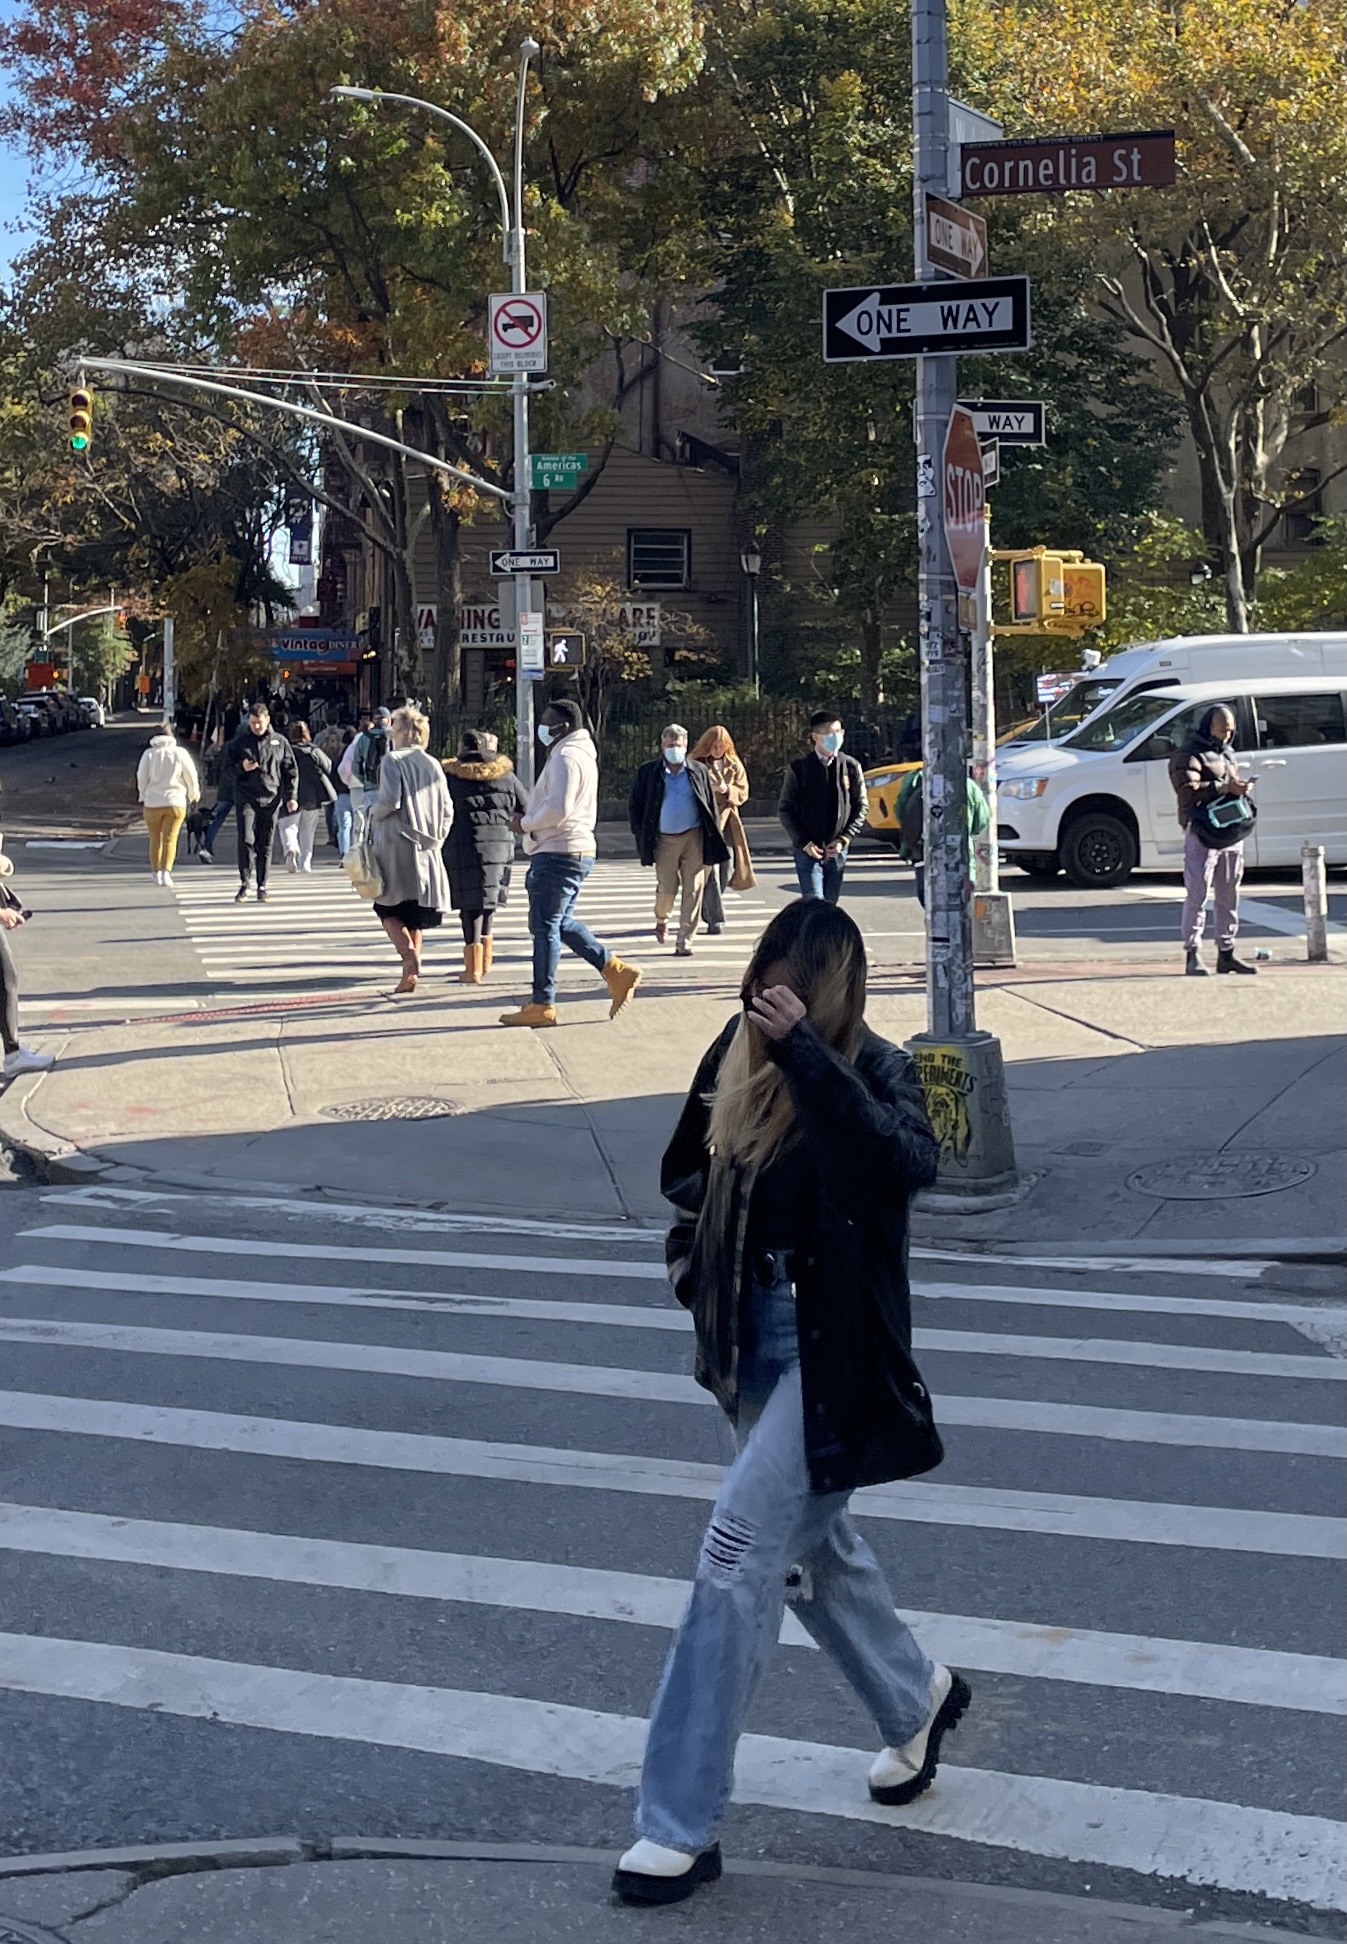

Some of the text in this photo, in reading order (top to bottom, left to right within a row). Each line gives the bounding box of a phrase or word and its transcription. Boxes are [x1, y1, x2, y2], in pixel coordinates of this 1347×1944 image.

[965, 147, 1142, 190] Cornelia St
[935, 218, 979, 262] ONE WAY
[856, 301, 1001, 336] ONE WAY
[988, 414, 1026, 431] WAY
[537, 461, 582, 470] Americas
[543, 473, 550, 487] 6
[946, 463, 982, 534] STOP
[502, 557, 549, 567] ONE WAY
[329, 640, 358, 650] DINER
[462, 632, 516, 644] RESTAU
[941, 1053, 963, 1069] THE
